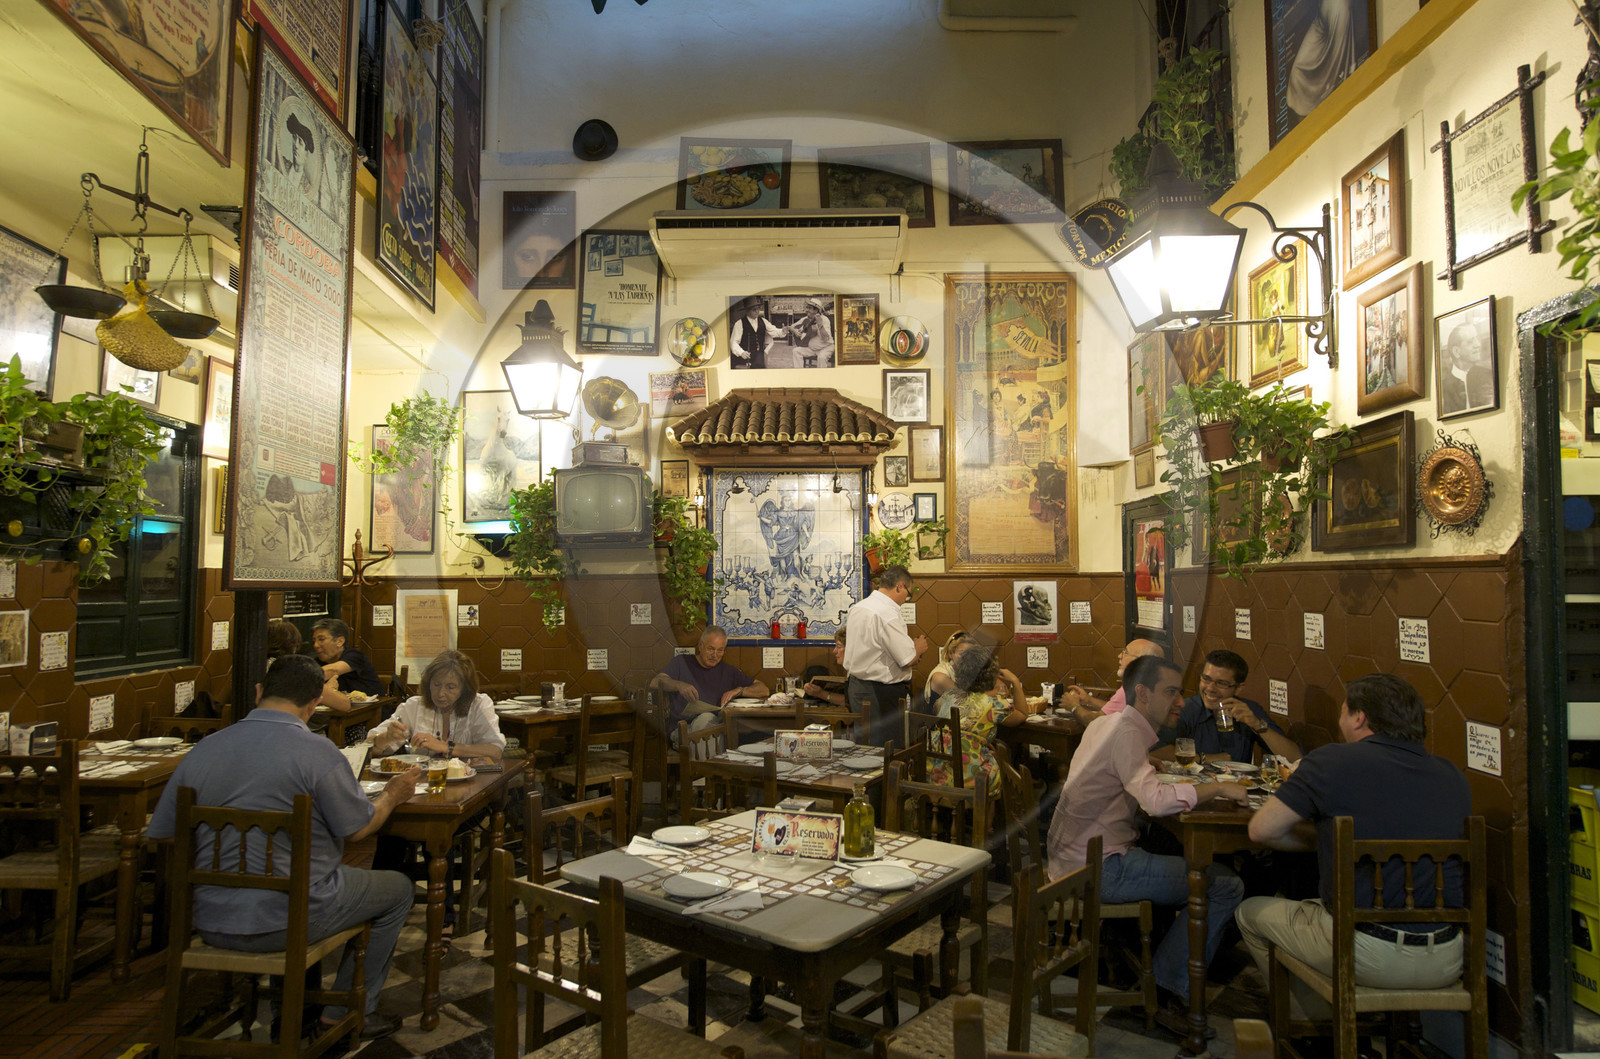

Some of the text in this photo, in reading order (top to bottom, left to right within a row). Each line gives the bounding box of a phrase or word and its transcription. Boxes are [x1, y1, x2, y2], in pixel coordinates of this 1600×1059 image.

[1455, 164, 1486, 192] NOVILLOS
[274, 216, 341, 278] CORDOBA
[264, 240, 286, 269] FERIA
[288, 258, 297, 277] DE
[300, 266, 321, 293] MAYO
[323, 284, 341, 307] 2000
[619, 283, 648, 292] HOMENAJE
[956, 283, 1006, 310] PLAZA
[1016, 283, 1067, 308] TOROS
[1013, 330, 1039, 354] SEVILLA
[1570, 863, 1591, 880] BRAS
[1572, 971, 1597, 992] ABRAS
